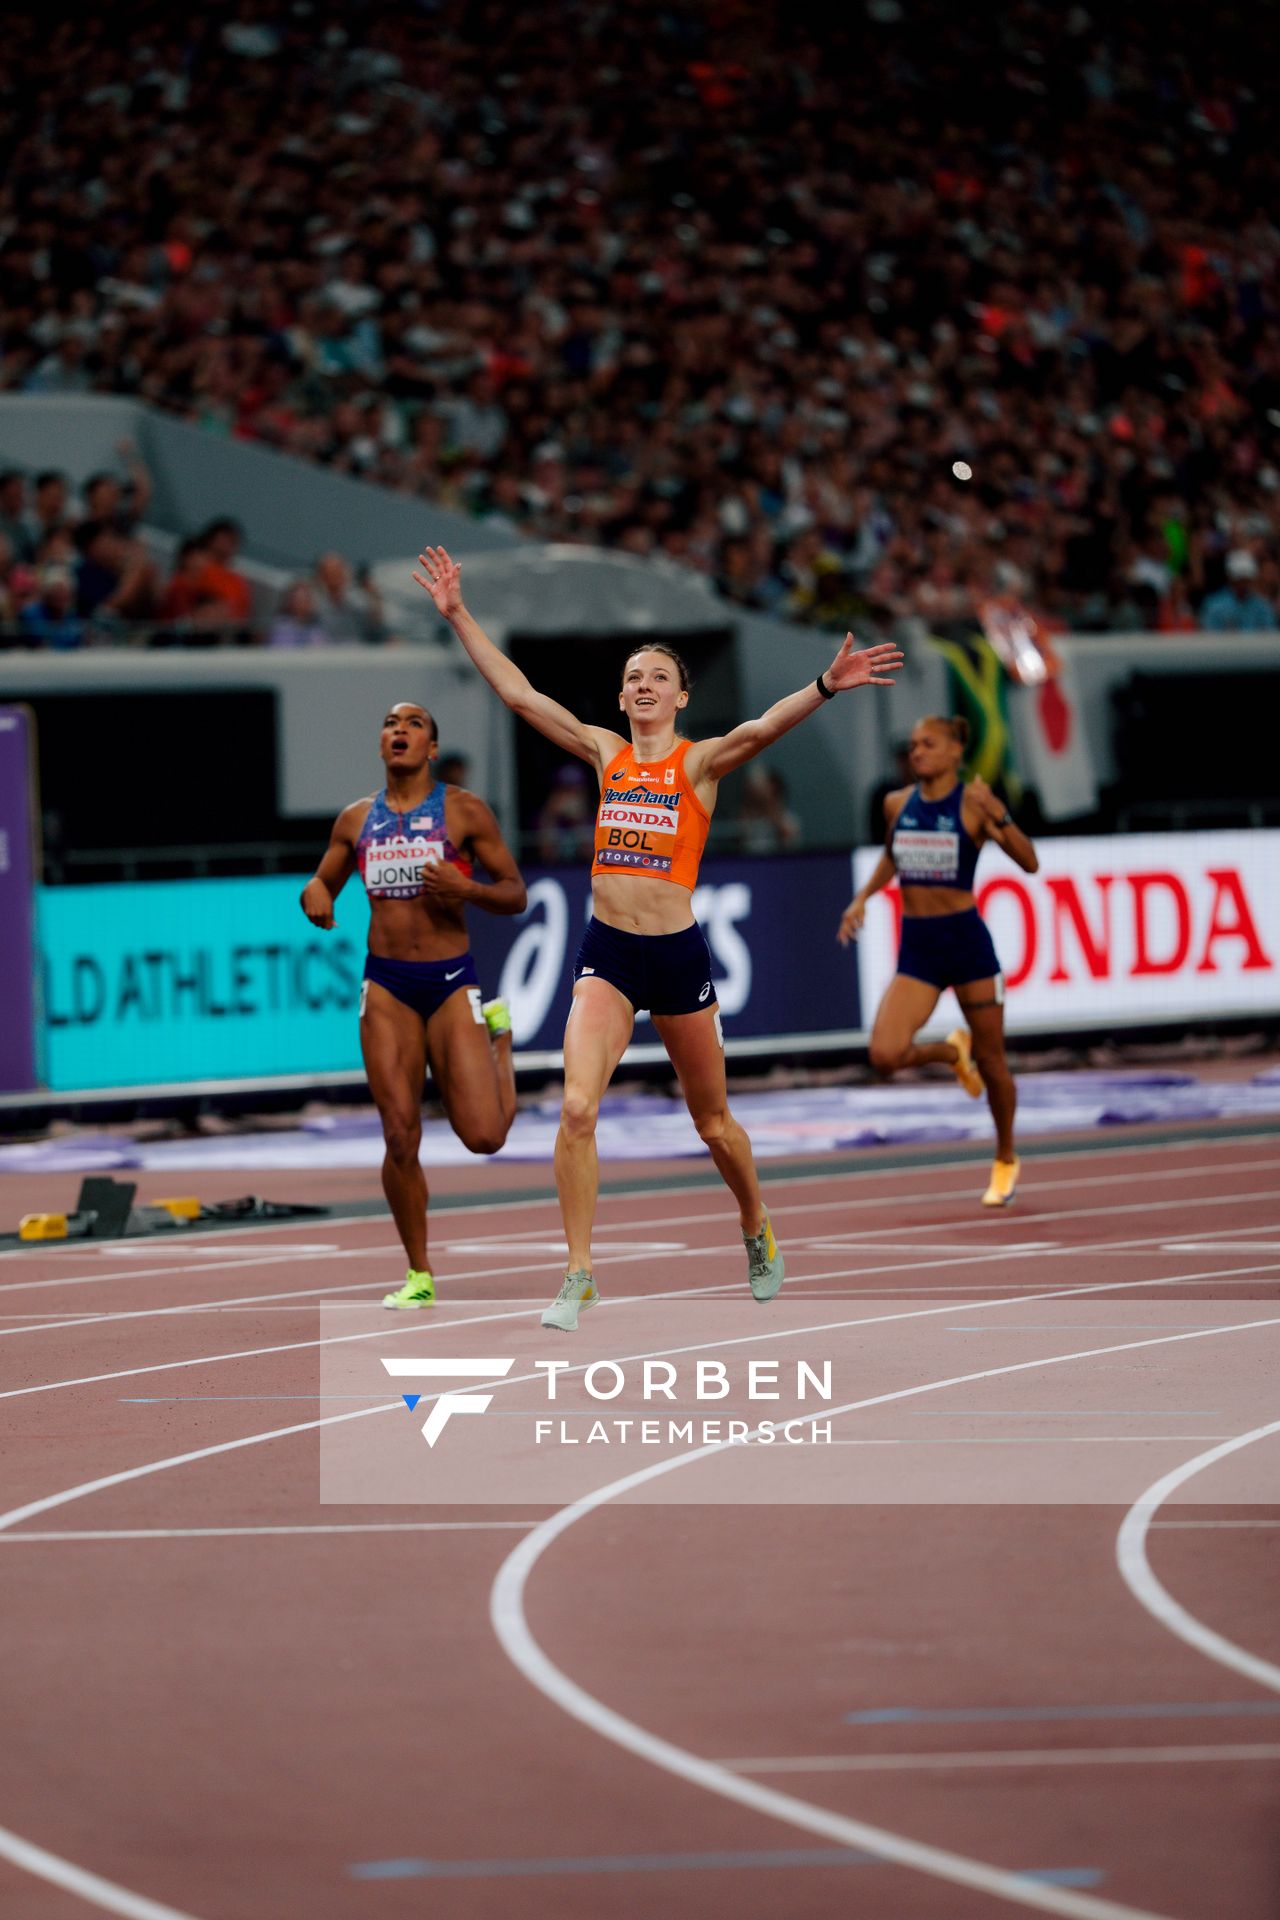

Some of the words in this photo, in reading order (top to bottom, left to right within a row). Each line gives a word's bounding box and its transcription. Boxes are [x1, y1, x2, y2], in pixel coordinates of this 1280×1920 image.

[601, 809, 675, 828] HONDA
[608, 828, 653, 851] BOL
[369, 846, 439, 862] HONDA
[371, 865, 425, 885] JONE
[115, 941, 358, 1024] ATHLETICS
